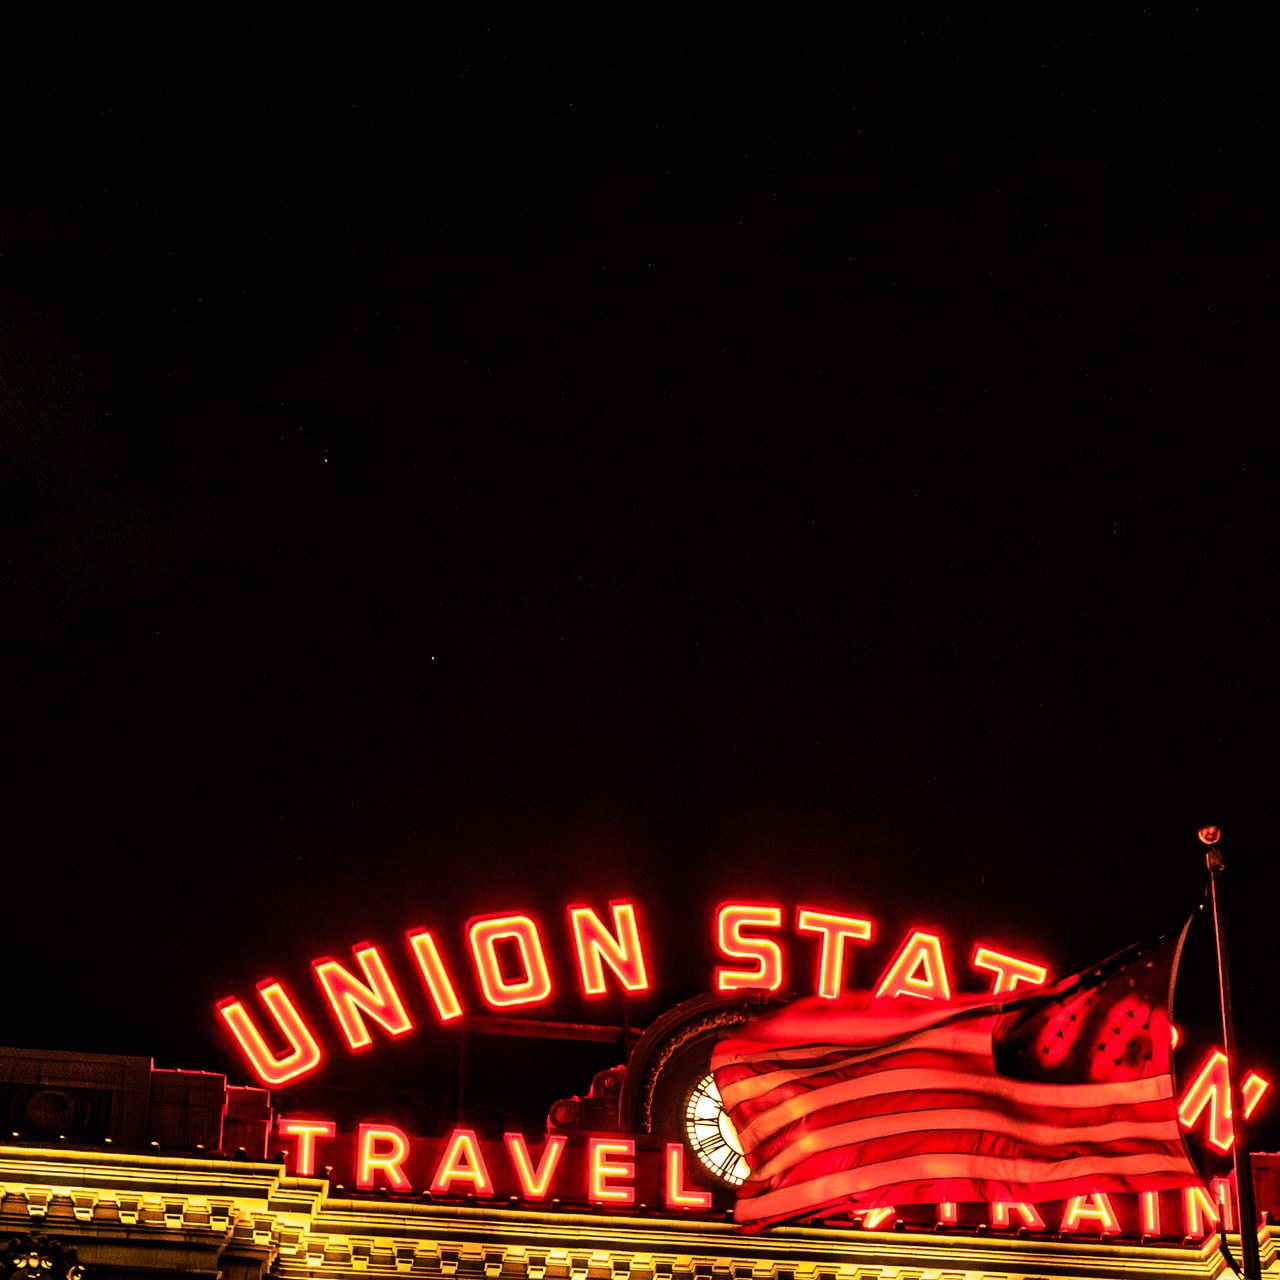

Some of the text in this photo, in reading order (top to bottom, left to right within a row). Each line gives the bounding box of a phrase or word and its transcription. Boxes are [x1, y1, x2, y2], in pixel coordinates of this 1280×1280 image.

[216, 899, 1270, 1152] UNION STATN
[279, 1118, 712, 1209] TRAVEL
